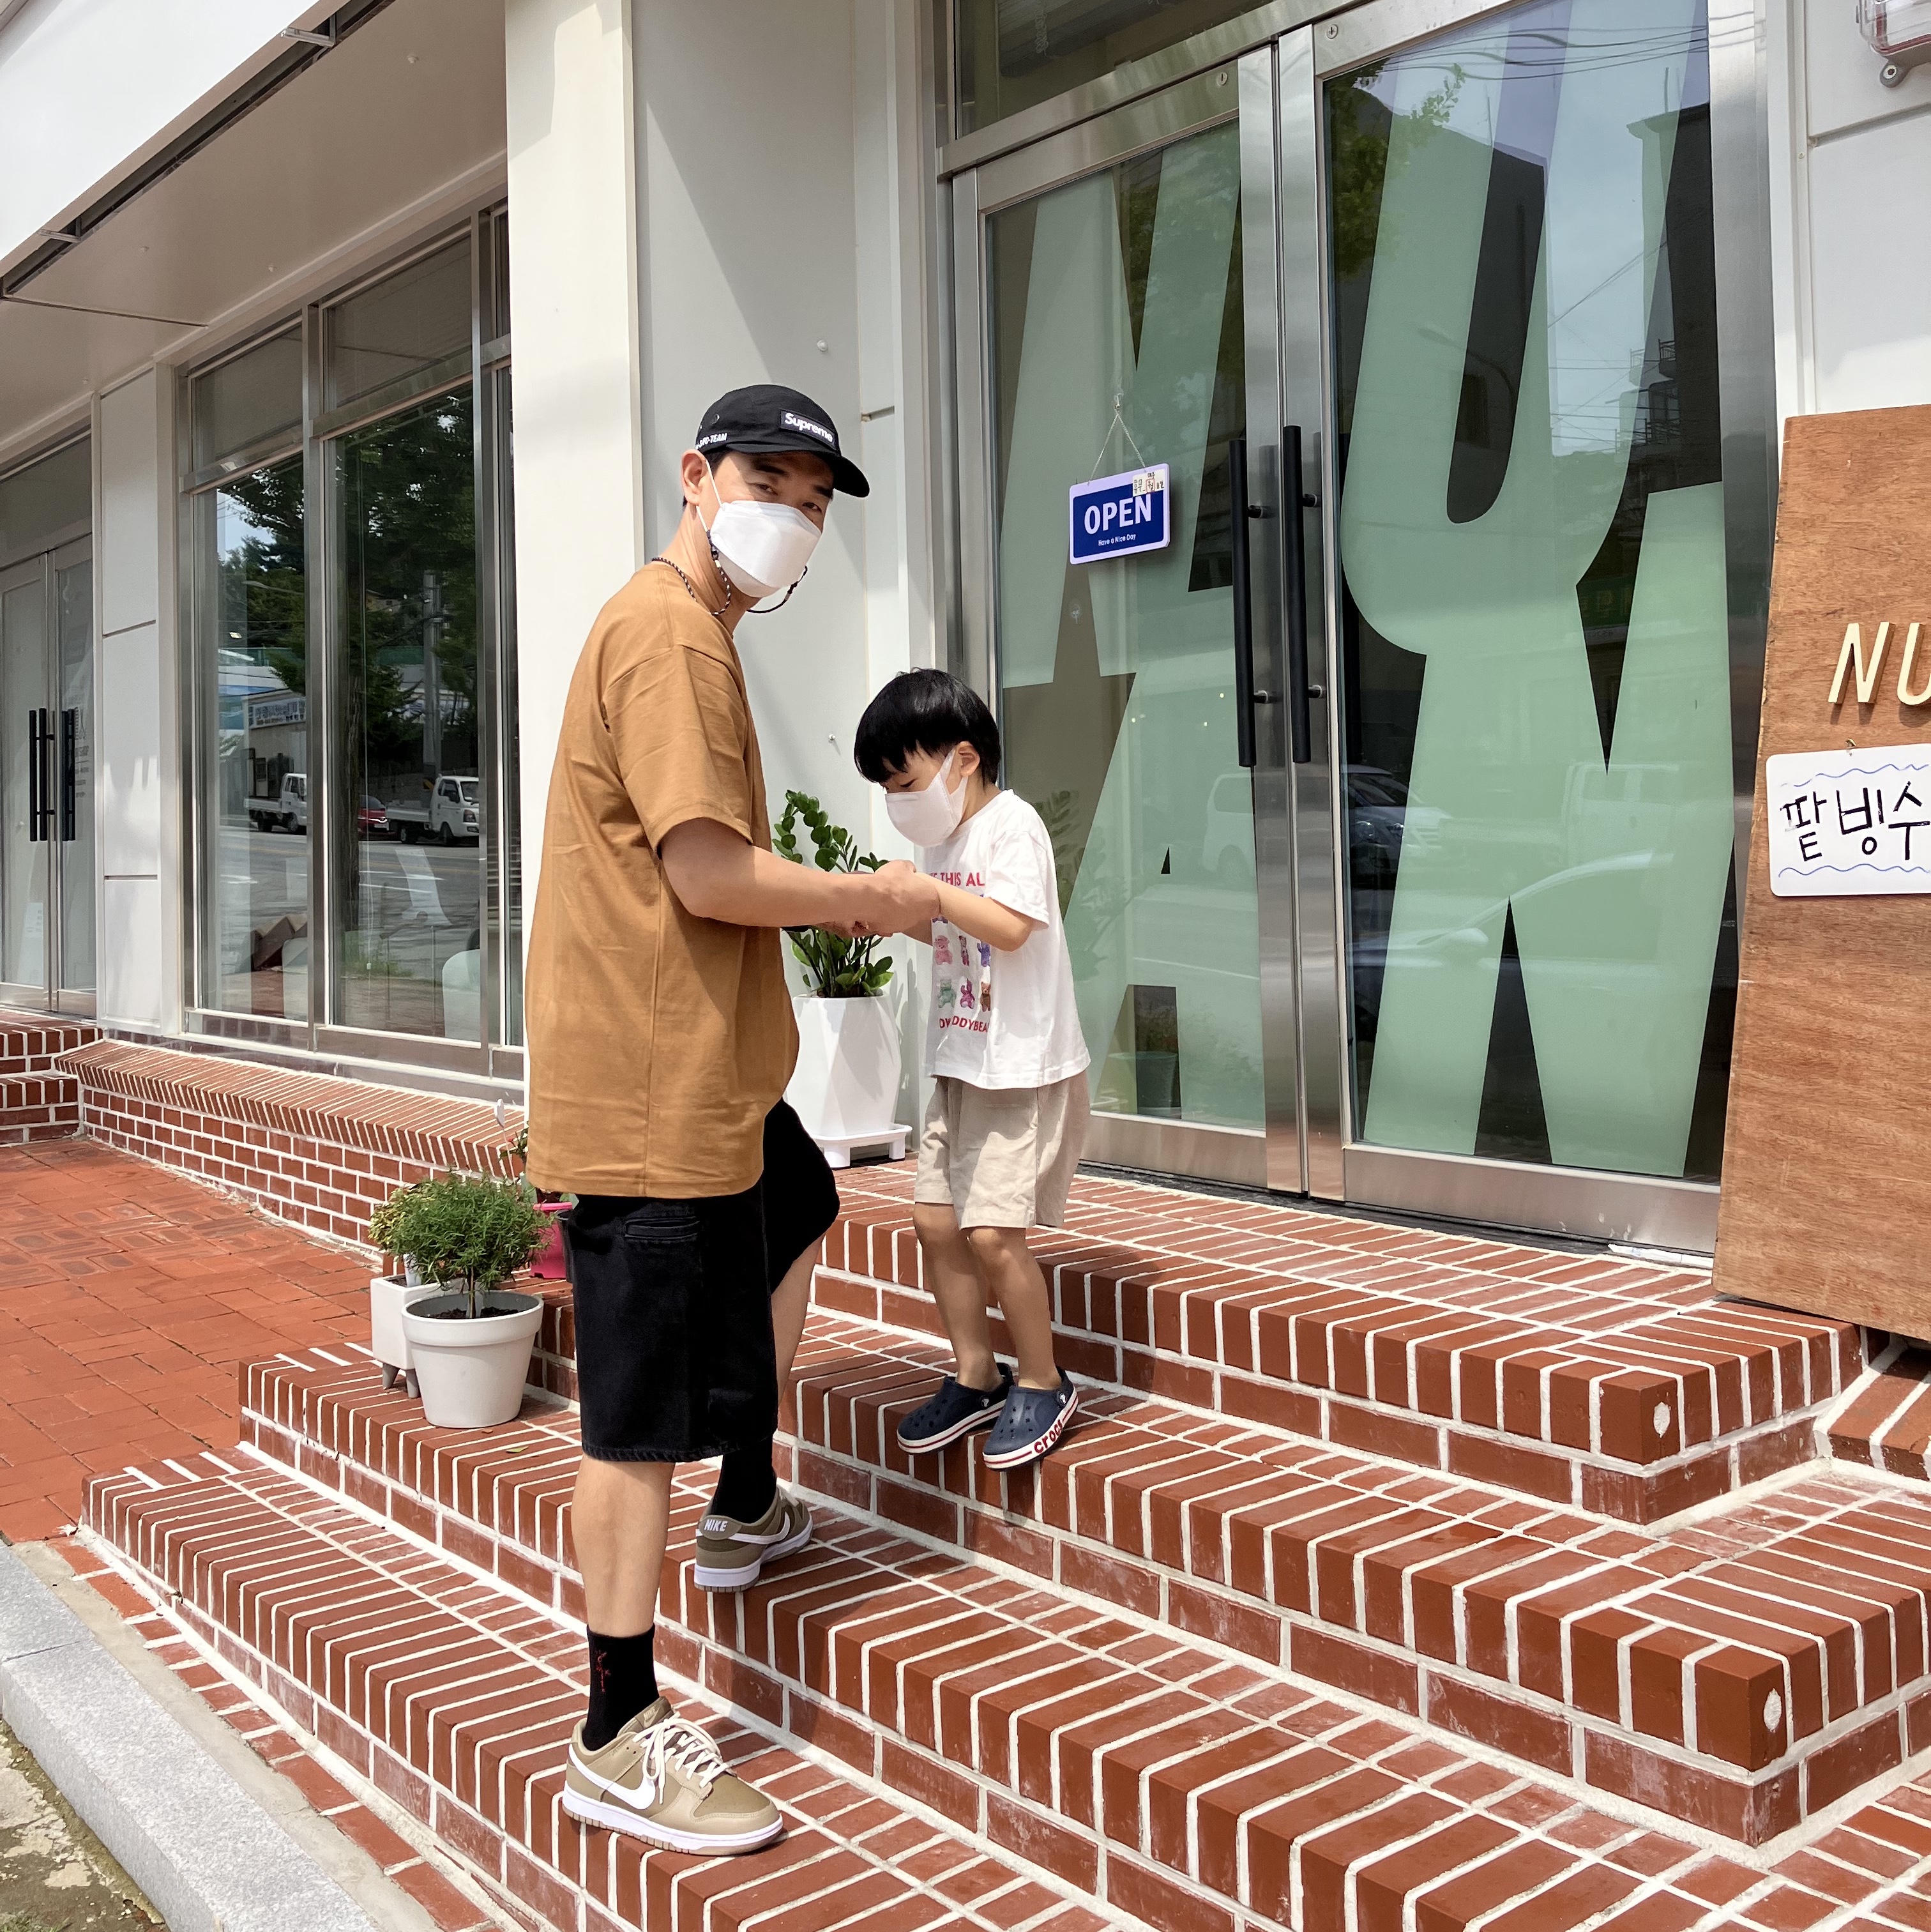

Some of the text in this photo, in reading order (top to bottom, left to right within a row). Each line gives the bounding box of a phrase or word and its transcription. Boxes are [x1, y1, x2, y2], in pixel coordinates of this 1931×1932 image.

[784, 413, 833, 442] Supreme
[1084, 494, 1151, 535] OPEN
[1115, 535, 1126, 544] Nice
[941, 872, 961, 886] THIS
[1034, 1419, 1063, 1454] crocs
[704, 1519, 728, 1532] NIKE
